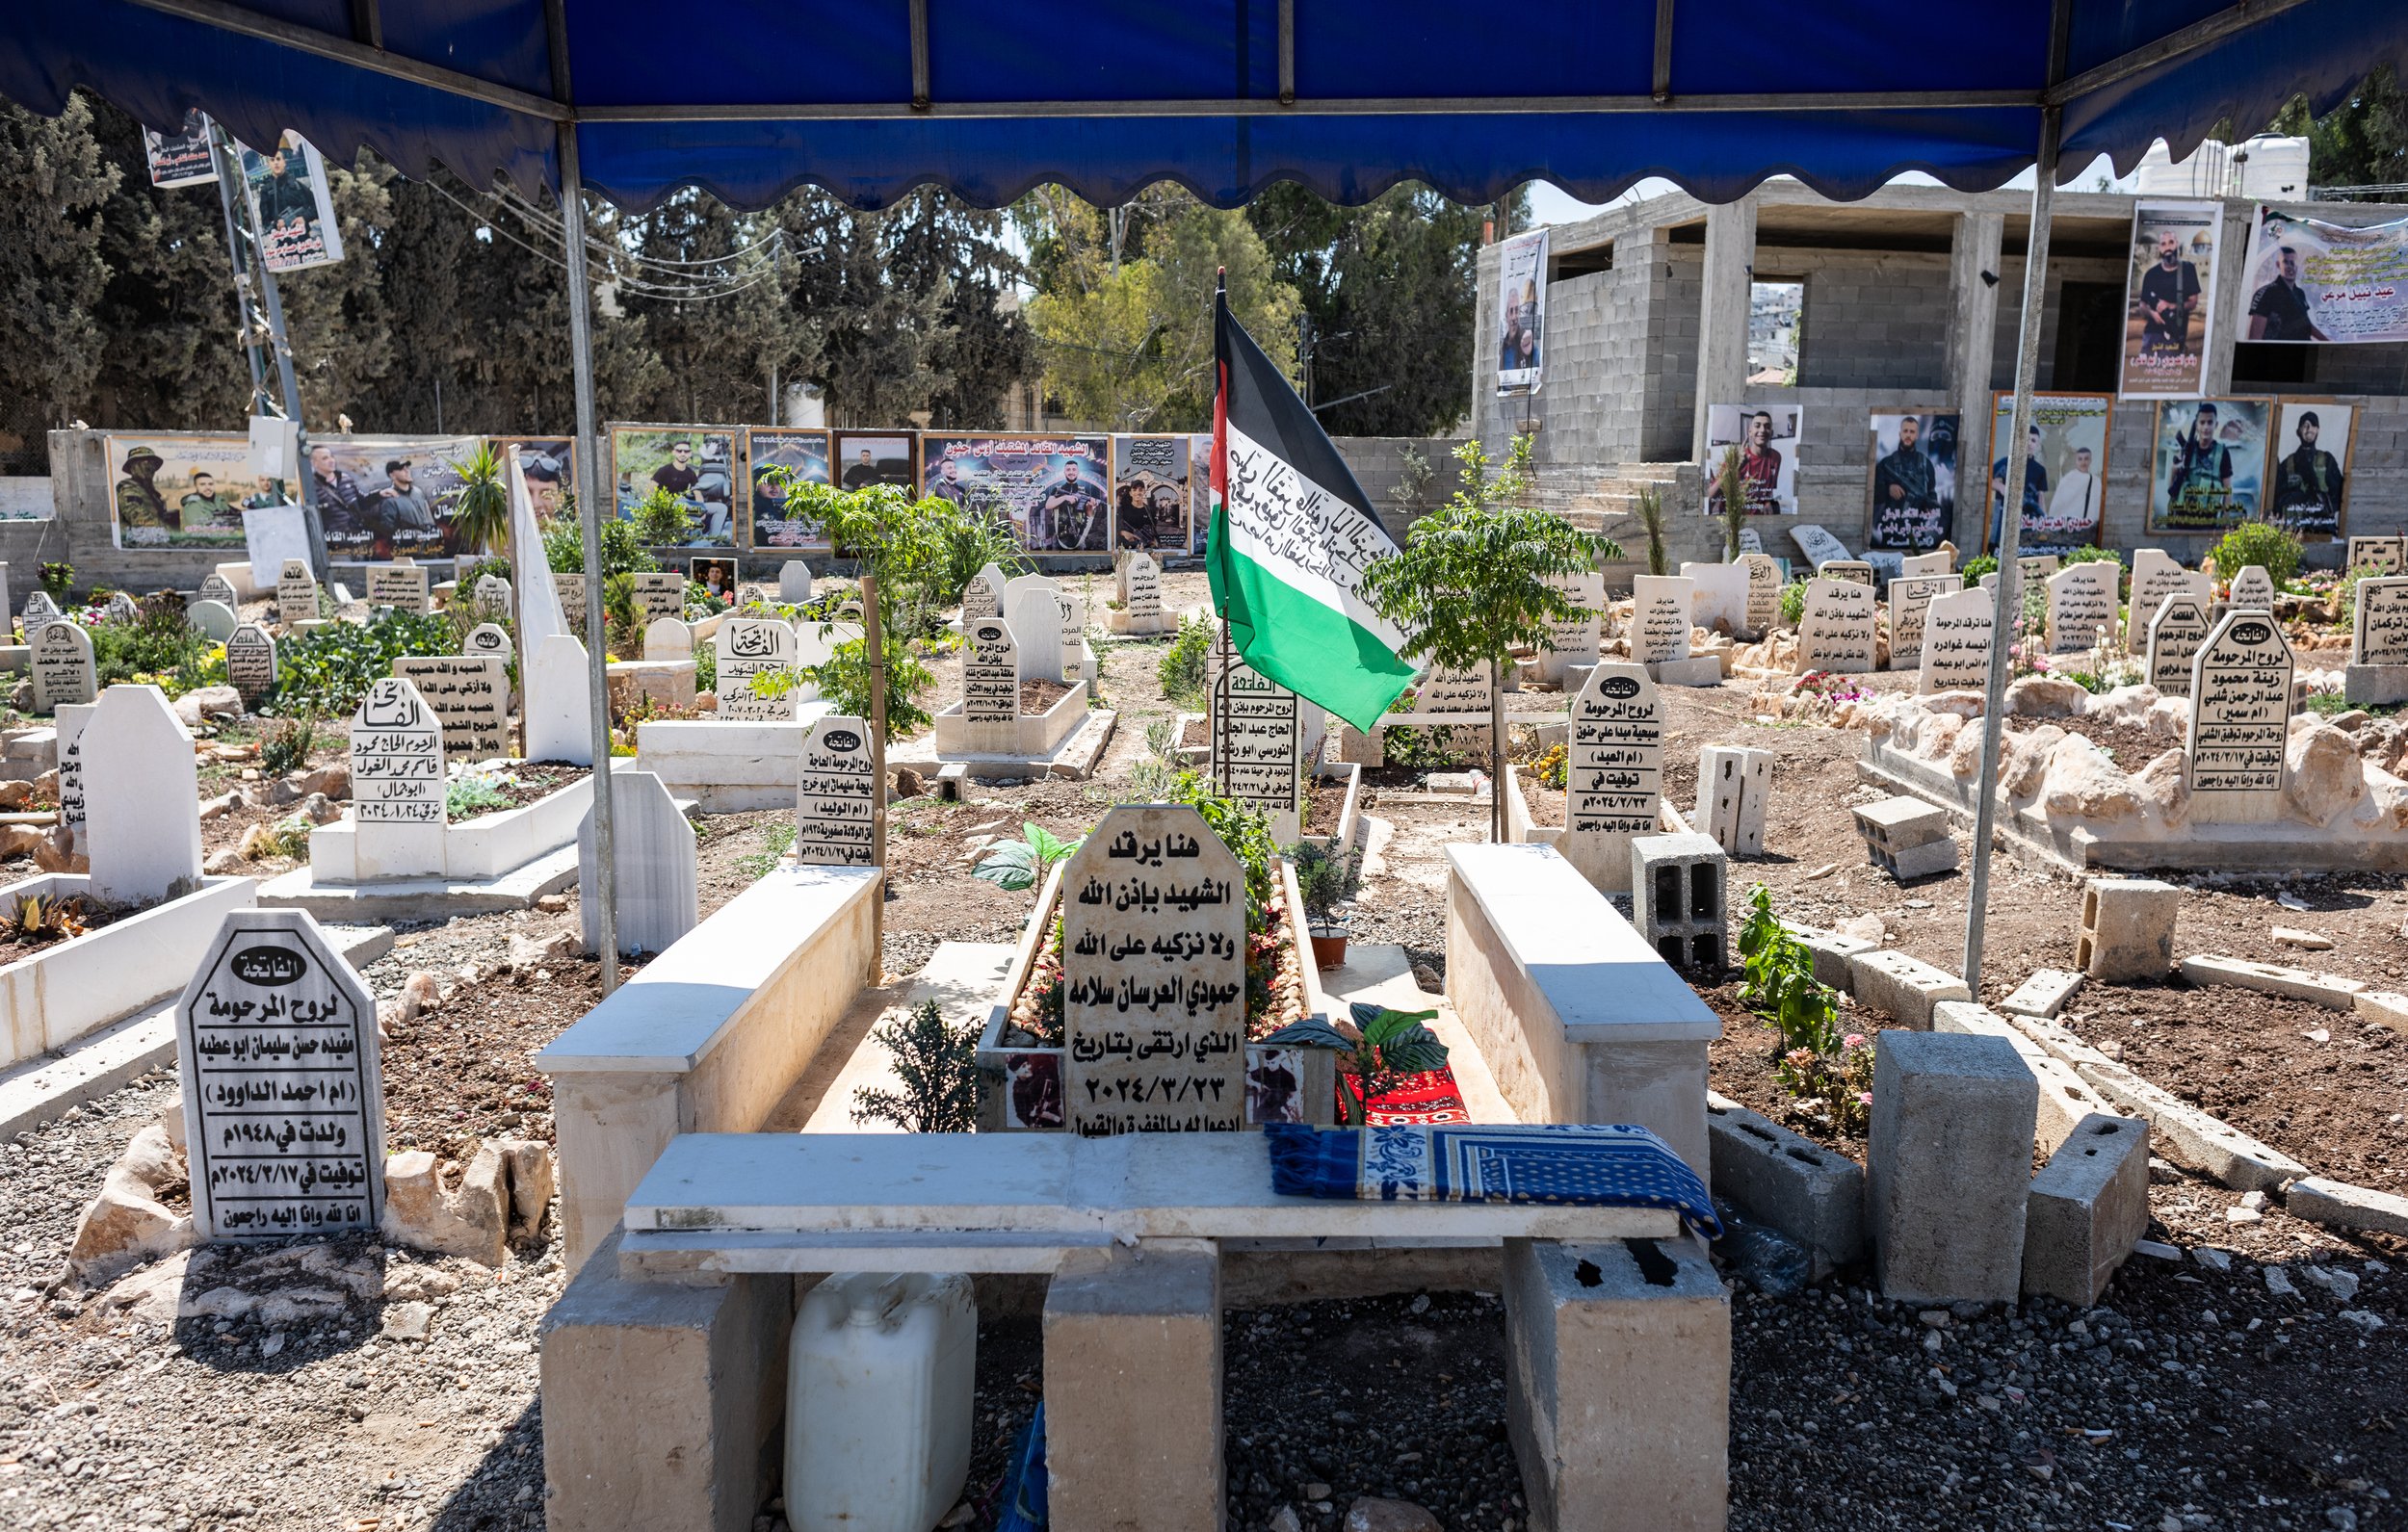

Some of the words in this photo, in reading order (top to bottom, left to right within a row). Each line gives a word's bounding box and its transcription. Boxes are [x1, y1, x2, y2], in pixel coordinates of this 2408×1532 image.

[1829, 588, 1847, 601] يرقد
[1851, 589, 1861, 598] هنا
[1815, 608, 1827, 617] الله
[1829, 609, 1844, 620] بإذن
[1846, 608, 1871, 620] الشهيد
[1936, 618, 1961, 630] المرحومة
[1965, 618, 1979, 630] ترقد
[1813, 628, 1823, 637] الله
[1825, 630, 1838, 639] على
[1841, 629, 1859, 640] نزكيه
[2236, 631, 2266, 641] الفاتحة
[995, 644, 1010, 653] لروح
[989, 655, 1002, 665] بإذن
[2212, 649, 2256, 665] المرحومة
[2258, 650, 2284, 666] لروح
[406, 663, 435, 675] حسيبه
[458, 661, 486, 673] أحسبه
[1232, 672, 1275, 694] الفاتحة
[2212, 674, 2249, 685] محمود
[2253, 671, 2280, 688] زينة
[424, 682, 436, 693] الله
[439, 684, 456, 694] على
[459, 680, 480, 696] أزكي
[482, 682, 491, 693] ولا
[1606, 682, 1636, 694] الفاتحة
[2204, 688, 2227, 706] شلبي
[2229, 690, 2264, 705] الرحمن
[2265, 691, 2284, 704] عبد
[1234, 704, 1249, 715] بإذن
[1250, 704, 1274, 714] المرحوم
[1275, 704, 1292, 715] لروح
[1584, 700, 1626, 717] المرحومة
[1628, 703, 1654, 718] لروح
[443, 721, 470, 732] الشهيد
[473, 720, 498, 732] ضريح
[1249, 723, 1267, 737] عبد
[1269, 724, 1292, 739] الحاج
[1577, 725, 1597, 740] حنون
[1598, 725, 1613, 742] علي
[1633, 726, 1659, 740] صبحية
[828, 736, 856, 747] الفاتحة
[2198, 728, 2220, 744] الشلبي
[2222, 730, 2240, 742] توفيق
[2241, 728, 2265, 741] المرحوم
[2266, 729, 2283, 742] زوجة
[67, 742, 79, 755] الله
[355, 735, 380, 755] محمود
[381, 735, 405, 752] الحاج
[406, 736, 436, 752] المرحوم
[1259, 743, 1292, 760] النورسي
[2256, 751, 2281, 766] توفيت
[357, 758, 390, 776] الغول
[809, 753, 831, 769] الحاجة
[833, 755, 857, 770] المرحومة
[2244, 750, 2254, 769] في
[390, 761, 409, 776] محمد
[802, 777, 818, 791] خرج
[820, 779, 829, 793] ابو
[831, 778, 854, 793] سليمان
[1261, 782, 1269, 794] في
[1272, 782, 1291, 794] توفي
[1592, 772, 1605, 791] في
[1607, 772, 1639, 789] توفيت
[821, 823, 843, 839] صفورية
[844, 825, 864, 840] الولادة
[1577, 820, 1601, 832] راجعون
[1632, 820, 1641, 831] لله
[1109, 830, 1162, 867] يرقد
[1166, 833, 1199, 857] هنا
[1079, 875, 1111, 905] الله
[1115, 877, 1159, 914] بإذن
[1165, 880, 1231, 912] الشهيد
[1075, 932, 1106, 955] الله
[1110, 933, 1146, 962] على
[1150, 931, 1205, 962] نزكيه
[1210, 931, 1235, 960] ولا
[241, 956, 298, 977] الفاتحة
[1069, 974, 1113, 1007] سلامه
[1117, 974, 1182, 1012] العرسان
[1187, 979, 1240, 1016] حمودي
[206, 992, 286, 1023] المرحومة
[291, 995, 337, 1023] لروح
[233, 1035, 249, 1062] ابو
[252, 1035, 290, 1060] سليمان
[293, 1035, 319, 1059] حسن
[1072, 1032, 1133, 1063] بتاريخ
[1138, 1032, 1190, 1059] ارتقى
[1194, 1032, 1237, 1063] الذي
[282, 1080, 326, 1103] احمد
[276, 1120, 297, 1152] في
[300, 1121, 346, 1148] ولدت
[300, 1163, 318, 1194] في
[319, 1161, 364, 1189] توفيت
[223, 1207, 267, 1228] راجعون
[326, 1203, 341, 1221] لله
